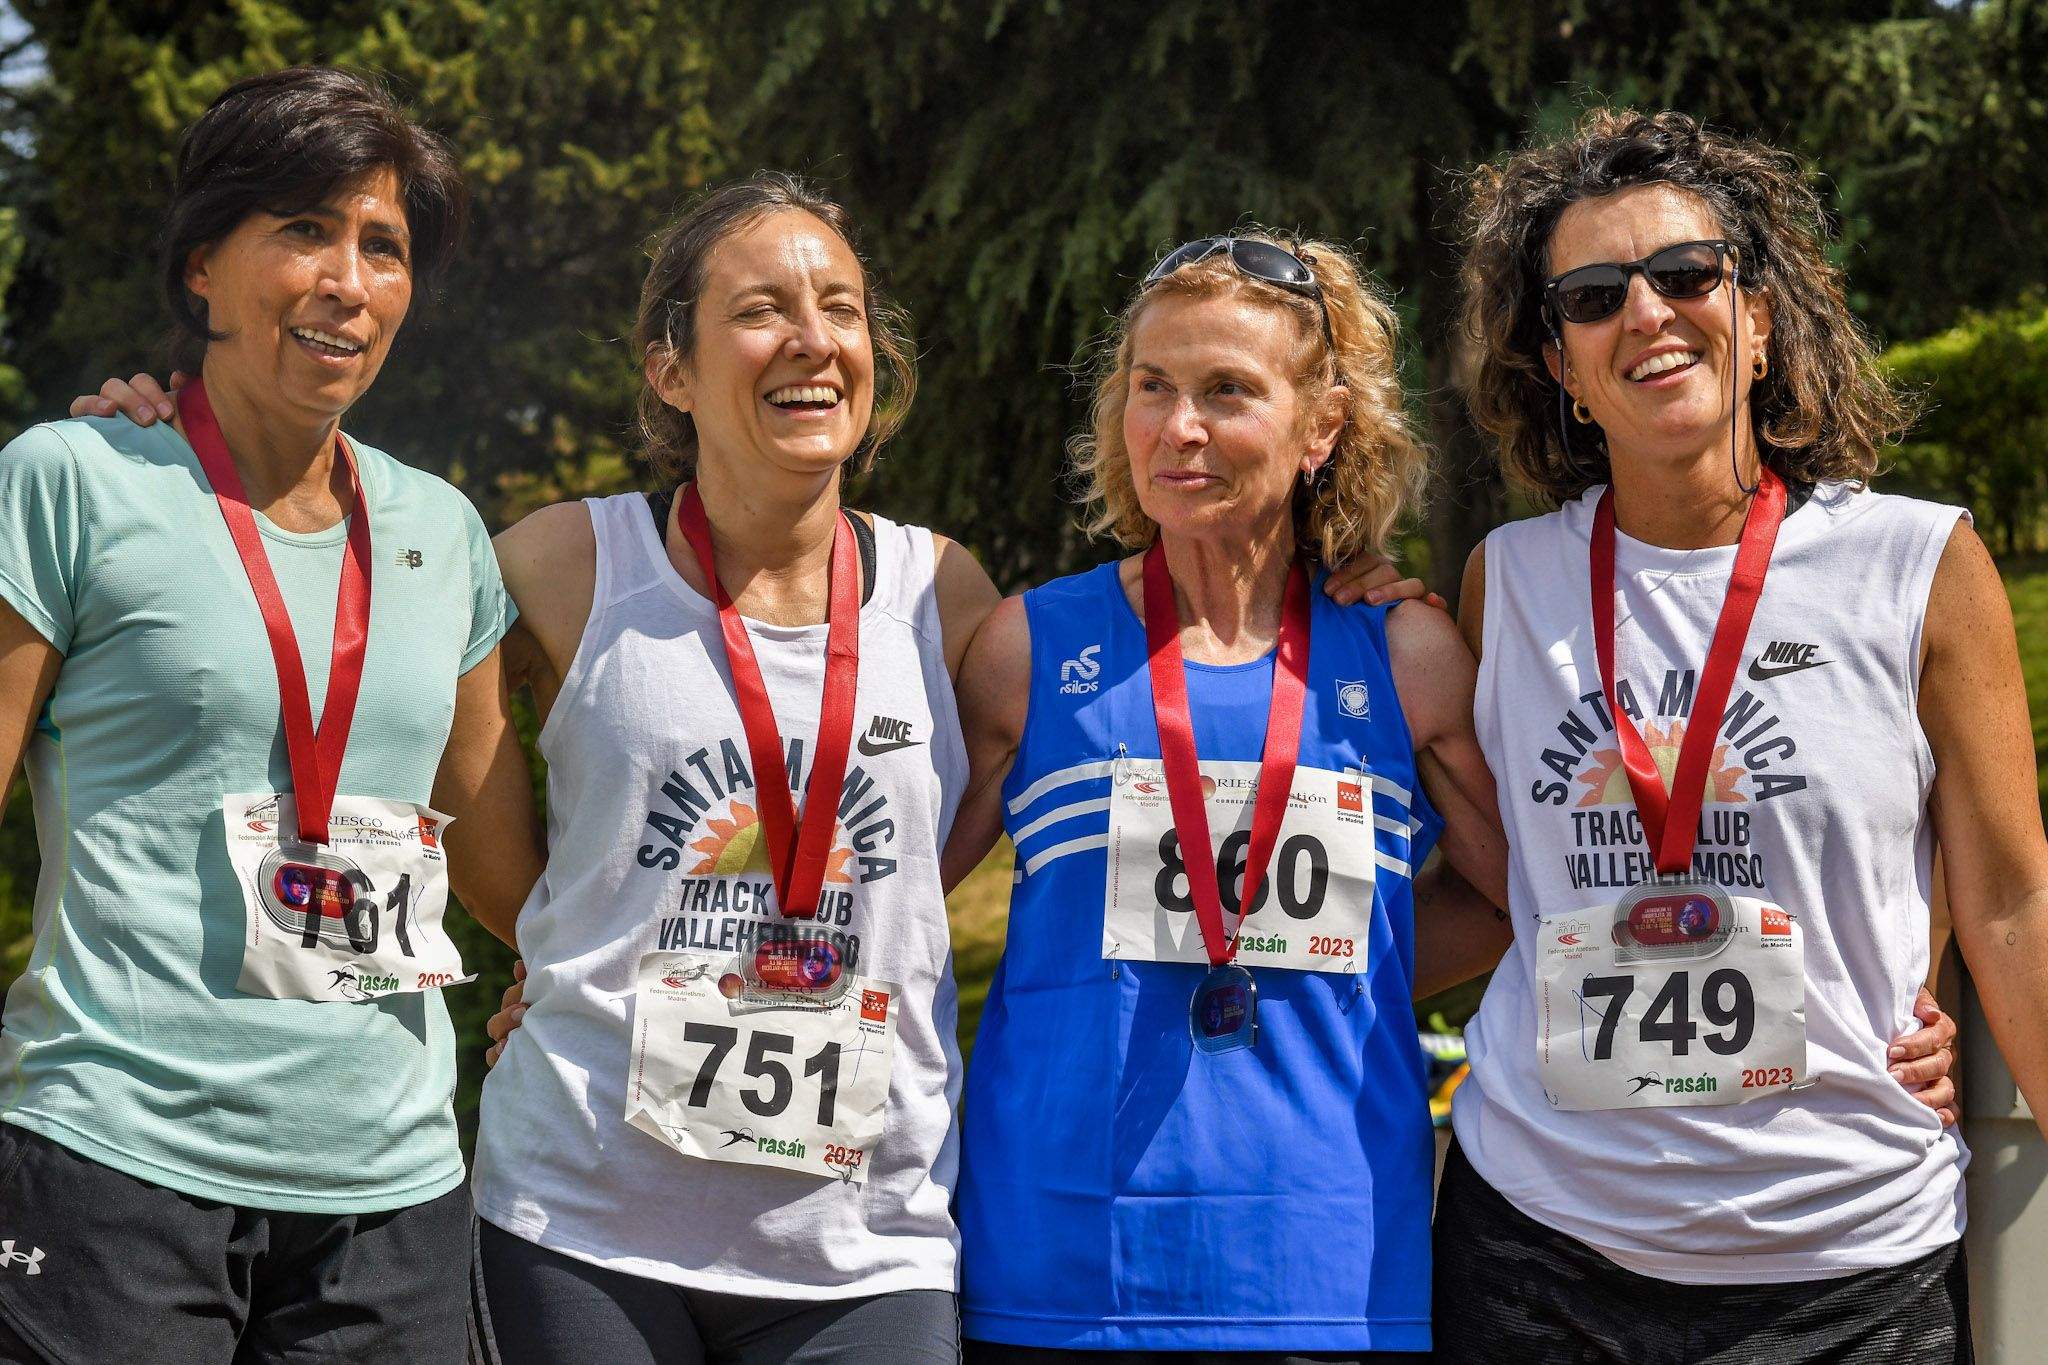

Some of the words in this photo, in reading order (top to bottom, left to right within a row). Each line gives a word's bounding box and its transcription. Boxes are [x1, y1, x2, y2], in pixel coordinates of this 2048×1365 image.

[1761, 641, 1819, 664] NIKE
[869, 715, 913, 742] NIKE
[1531, 679, 1644, 806] SANTA
[1657, 669, 1807, 802] MNICA
[1217, 778, 1258, 789] RIES
[637, 738, 754, 871] SANTA
[779, 736, 897, 884] MNICA
[1337, 811, 1364, 819] Comunidad
[1345, 817, 1364, 825] Madrid
[355, 828, 363, 838] y
[1571, 810, 1643, 847] TRAC
[1697, 810, 1751, 847] LUB
[1154, 828, 1329, 920] 860
[1564, 851, 1766, 889] VALLEHMOSO
[680, 879, 773, 915] TRACK
[1237, 933, 1287, 954] rasán
[1309, 935, 1354, 957] 2023
[358, 972, 400, 992] rasán
[1583, 968, 1756, 1061] 749
[866, 1027, 886, 1036] Madrid
[683, 1022, 842, 1127] 751
[1665, 1072, 1717, 1094] rasán
[1741, 1067, 1794, 1089] 2023
[757, 1136, 806, 1159] rasán
[824, 1143, 863, 1167] 2023
